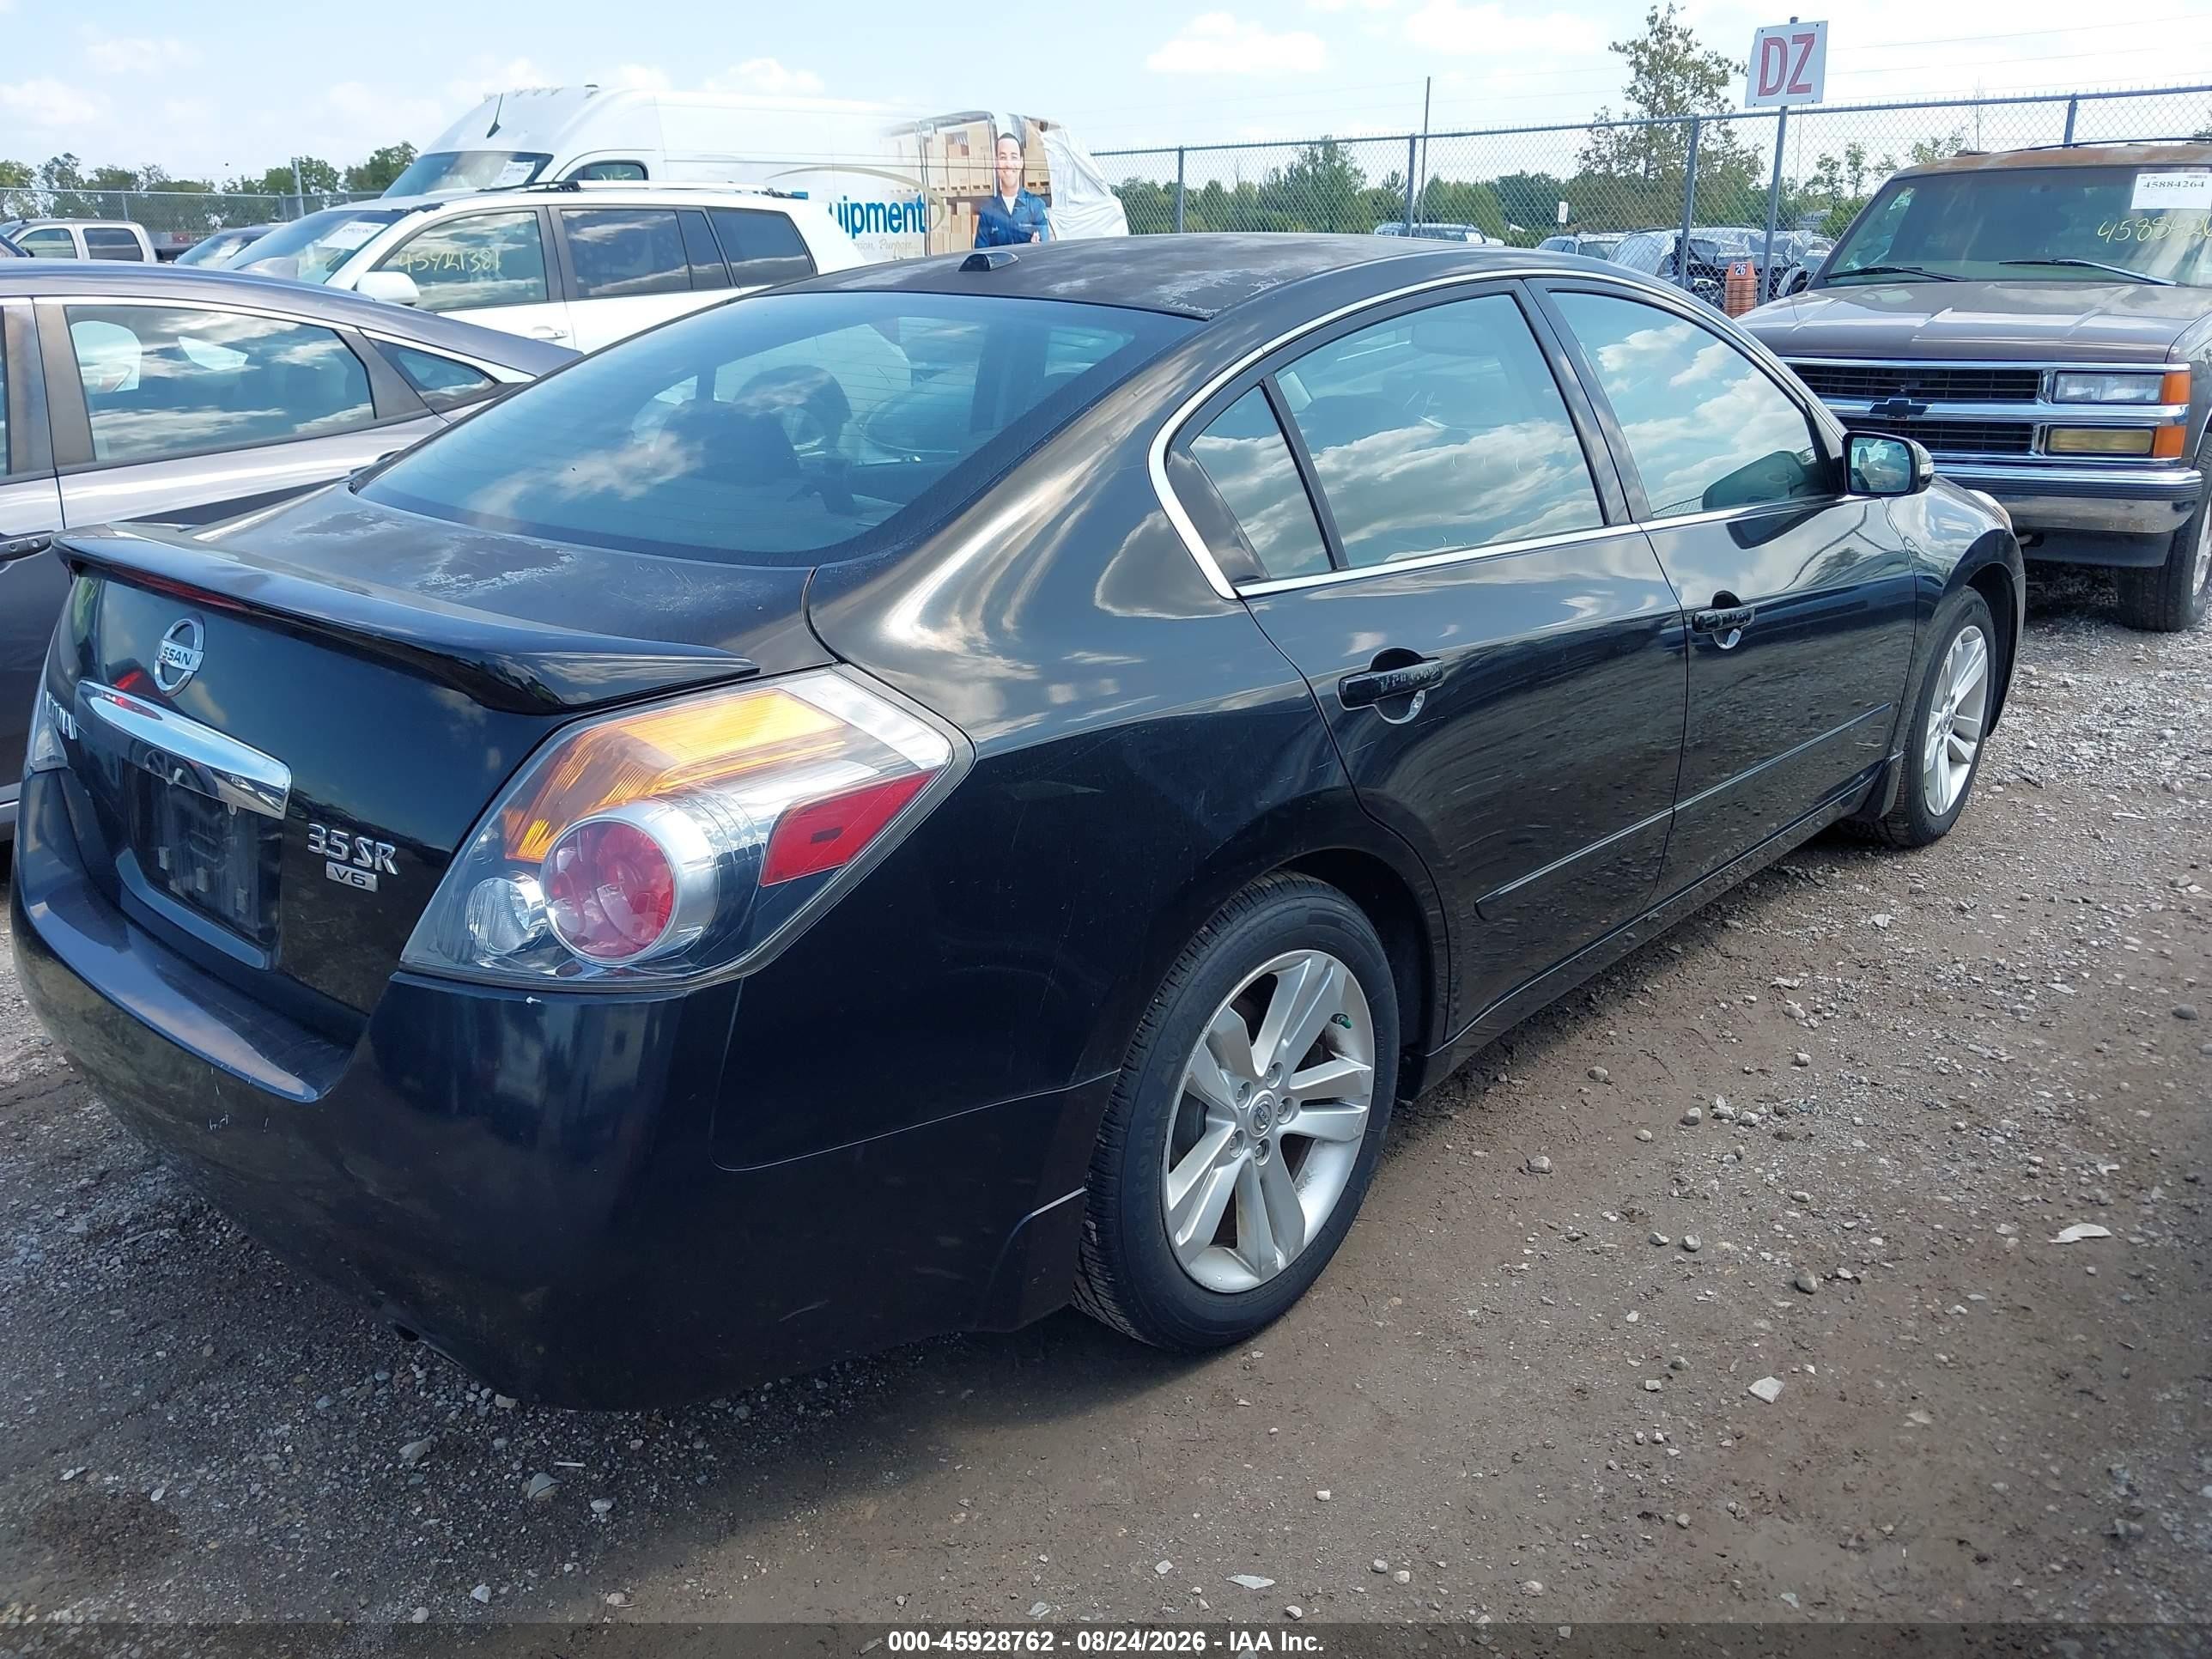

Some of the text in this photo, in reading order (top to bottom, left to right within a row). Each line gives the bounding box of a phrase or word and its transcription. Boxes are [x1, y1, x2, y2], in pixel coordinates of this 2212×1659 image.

[1757, 33, 1816, 97] DZ
[2142, 180, 2205, 189] 45884264
[1735, 264, 1747, 276] 26
[353, 836, 398, 875] SR
[333, 866, 366, 887] V6
